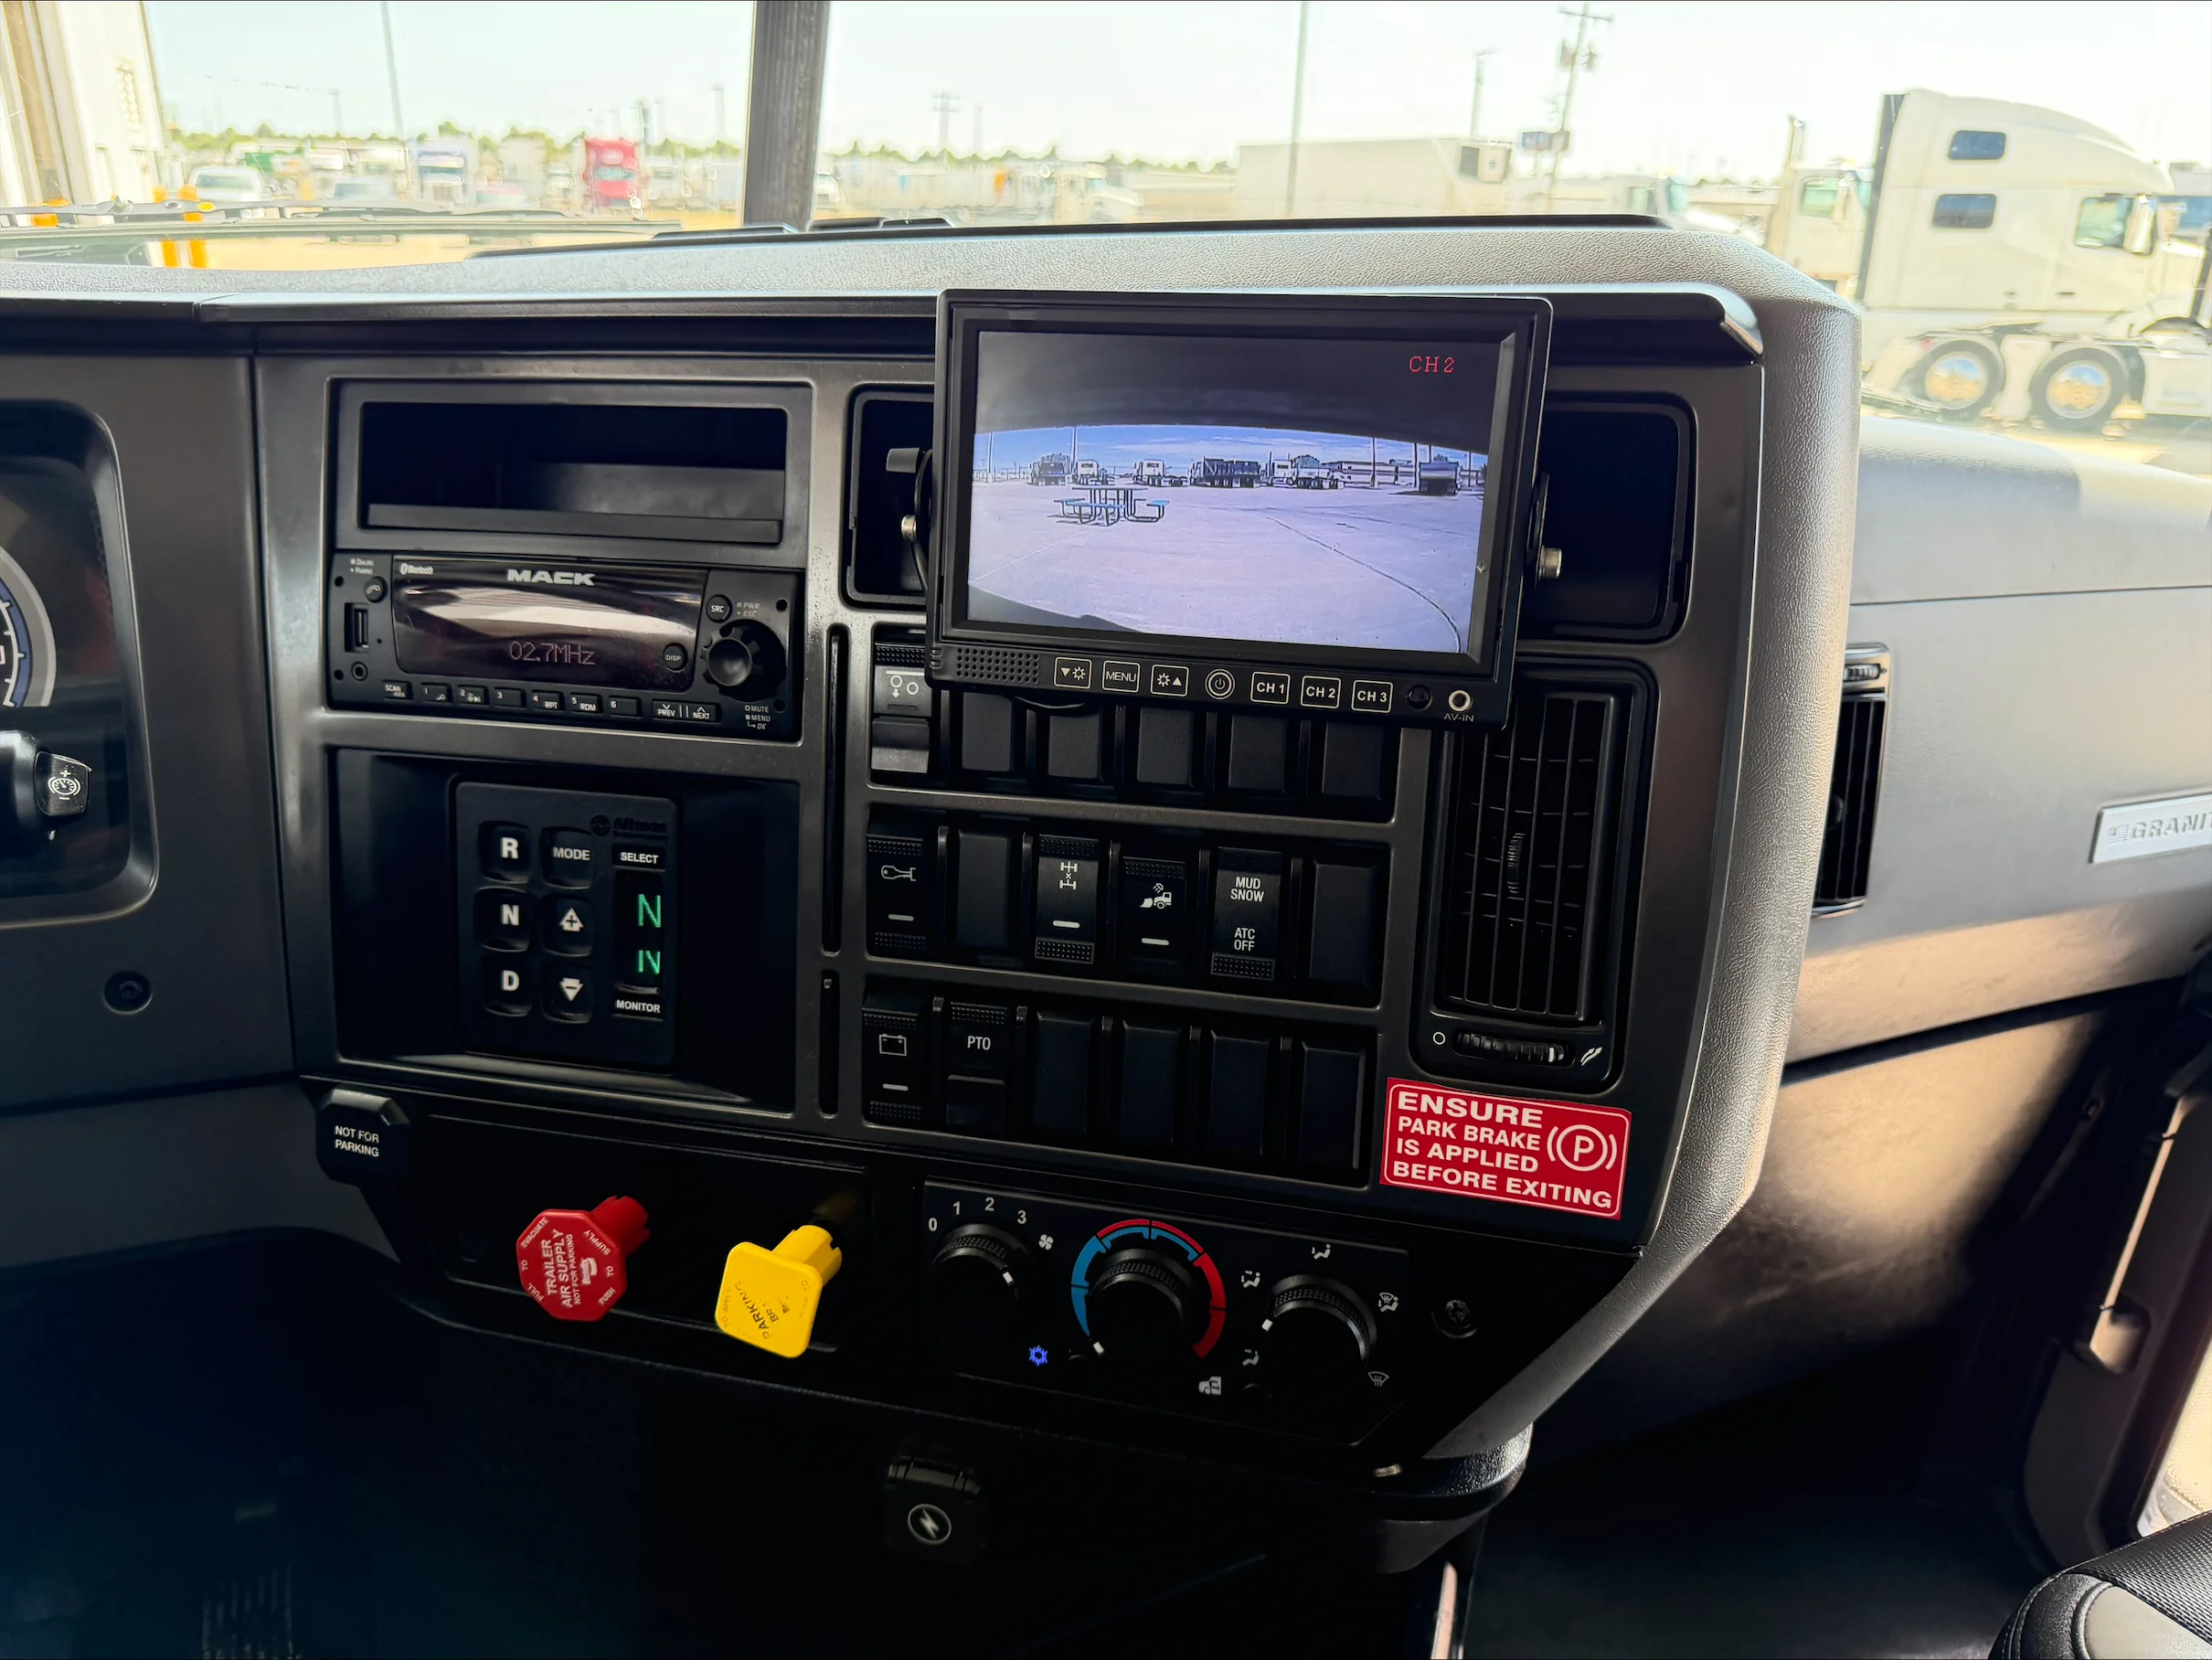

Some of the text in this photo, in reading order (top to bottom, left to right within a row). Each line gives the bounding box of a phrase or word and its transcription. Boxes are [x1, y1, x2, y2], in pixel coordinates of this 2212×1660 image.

[507, 569, 596, 586] MACK
[711, 605, 725, 613] SRC
[1106, 671, 1136, 682] MENU
[385, 685, 401, 693] SCAN
[497, 691, 503, 699] 3
[1256, 681, 1285, 695] CH 1
[1305, 686, 1335, 698] CH 2
[1356, 690, 1388, 703] CH 3
[545, 701, 558, 709] RPT
[580, 703, 596, 711] RDM
[658, 708, 675, 717] PREV
[693, 712, 710, 720] NEXT
[751, 714, 771, 722] MENU
[1443, 712, 1474, 722] AV-IN
[501, 836, 519, 860] R
[553, 846, 590, 861] MODE
[620, 851, 659, 865] SELECT
[1235, 876, 1261, 890] MUD
[1229, 887, 1265, 903] SNOW
[501, 904, 520, 926] N
[637, 893, 662, 929] N
[1234, 927, 1256, 941] ATC
[1234, 939, 1255, 952] OFF
[501, 970, 520, 992] D
[615, 999, 661, 1014] MONITOR
[967, 1036, 991, 1051] PTO
[1398, 1091, 1544, 1129] ENSURE
[335, 1125, 379, 1144] NOT FOR
[1398, 1116, 1540, 1151] PARK BRAKE
[335, 1139, 379, 1157] PARKING
[1396, 1138, 1539, 1173] IS APPLIED
[1393, 1161, 1612, 1209] BEFORE EXITING
[952, 1200, 961, 1216] 1
[984, 1197, 995, 1212] 2
[1017, 1209, 1026, 1225] 3
[928, 1218, 938, 1232] 0
[520, 1216, 549, 1302] PULL TO EVACUATE
[541, 1239, 558, 1295] TRAILER
[552, 1229, 573, 1308] AIR SUPPLY
[566, 1233, 581, 1305] NOT FOR PARKING
[584, 1229, 616, 1305] PUSH TO SUPPLY
